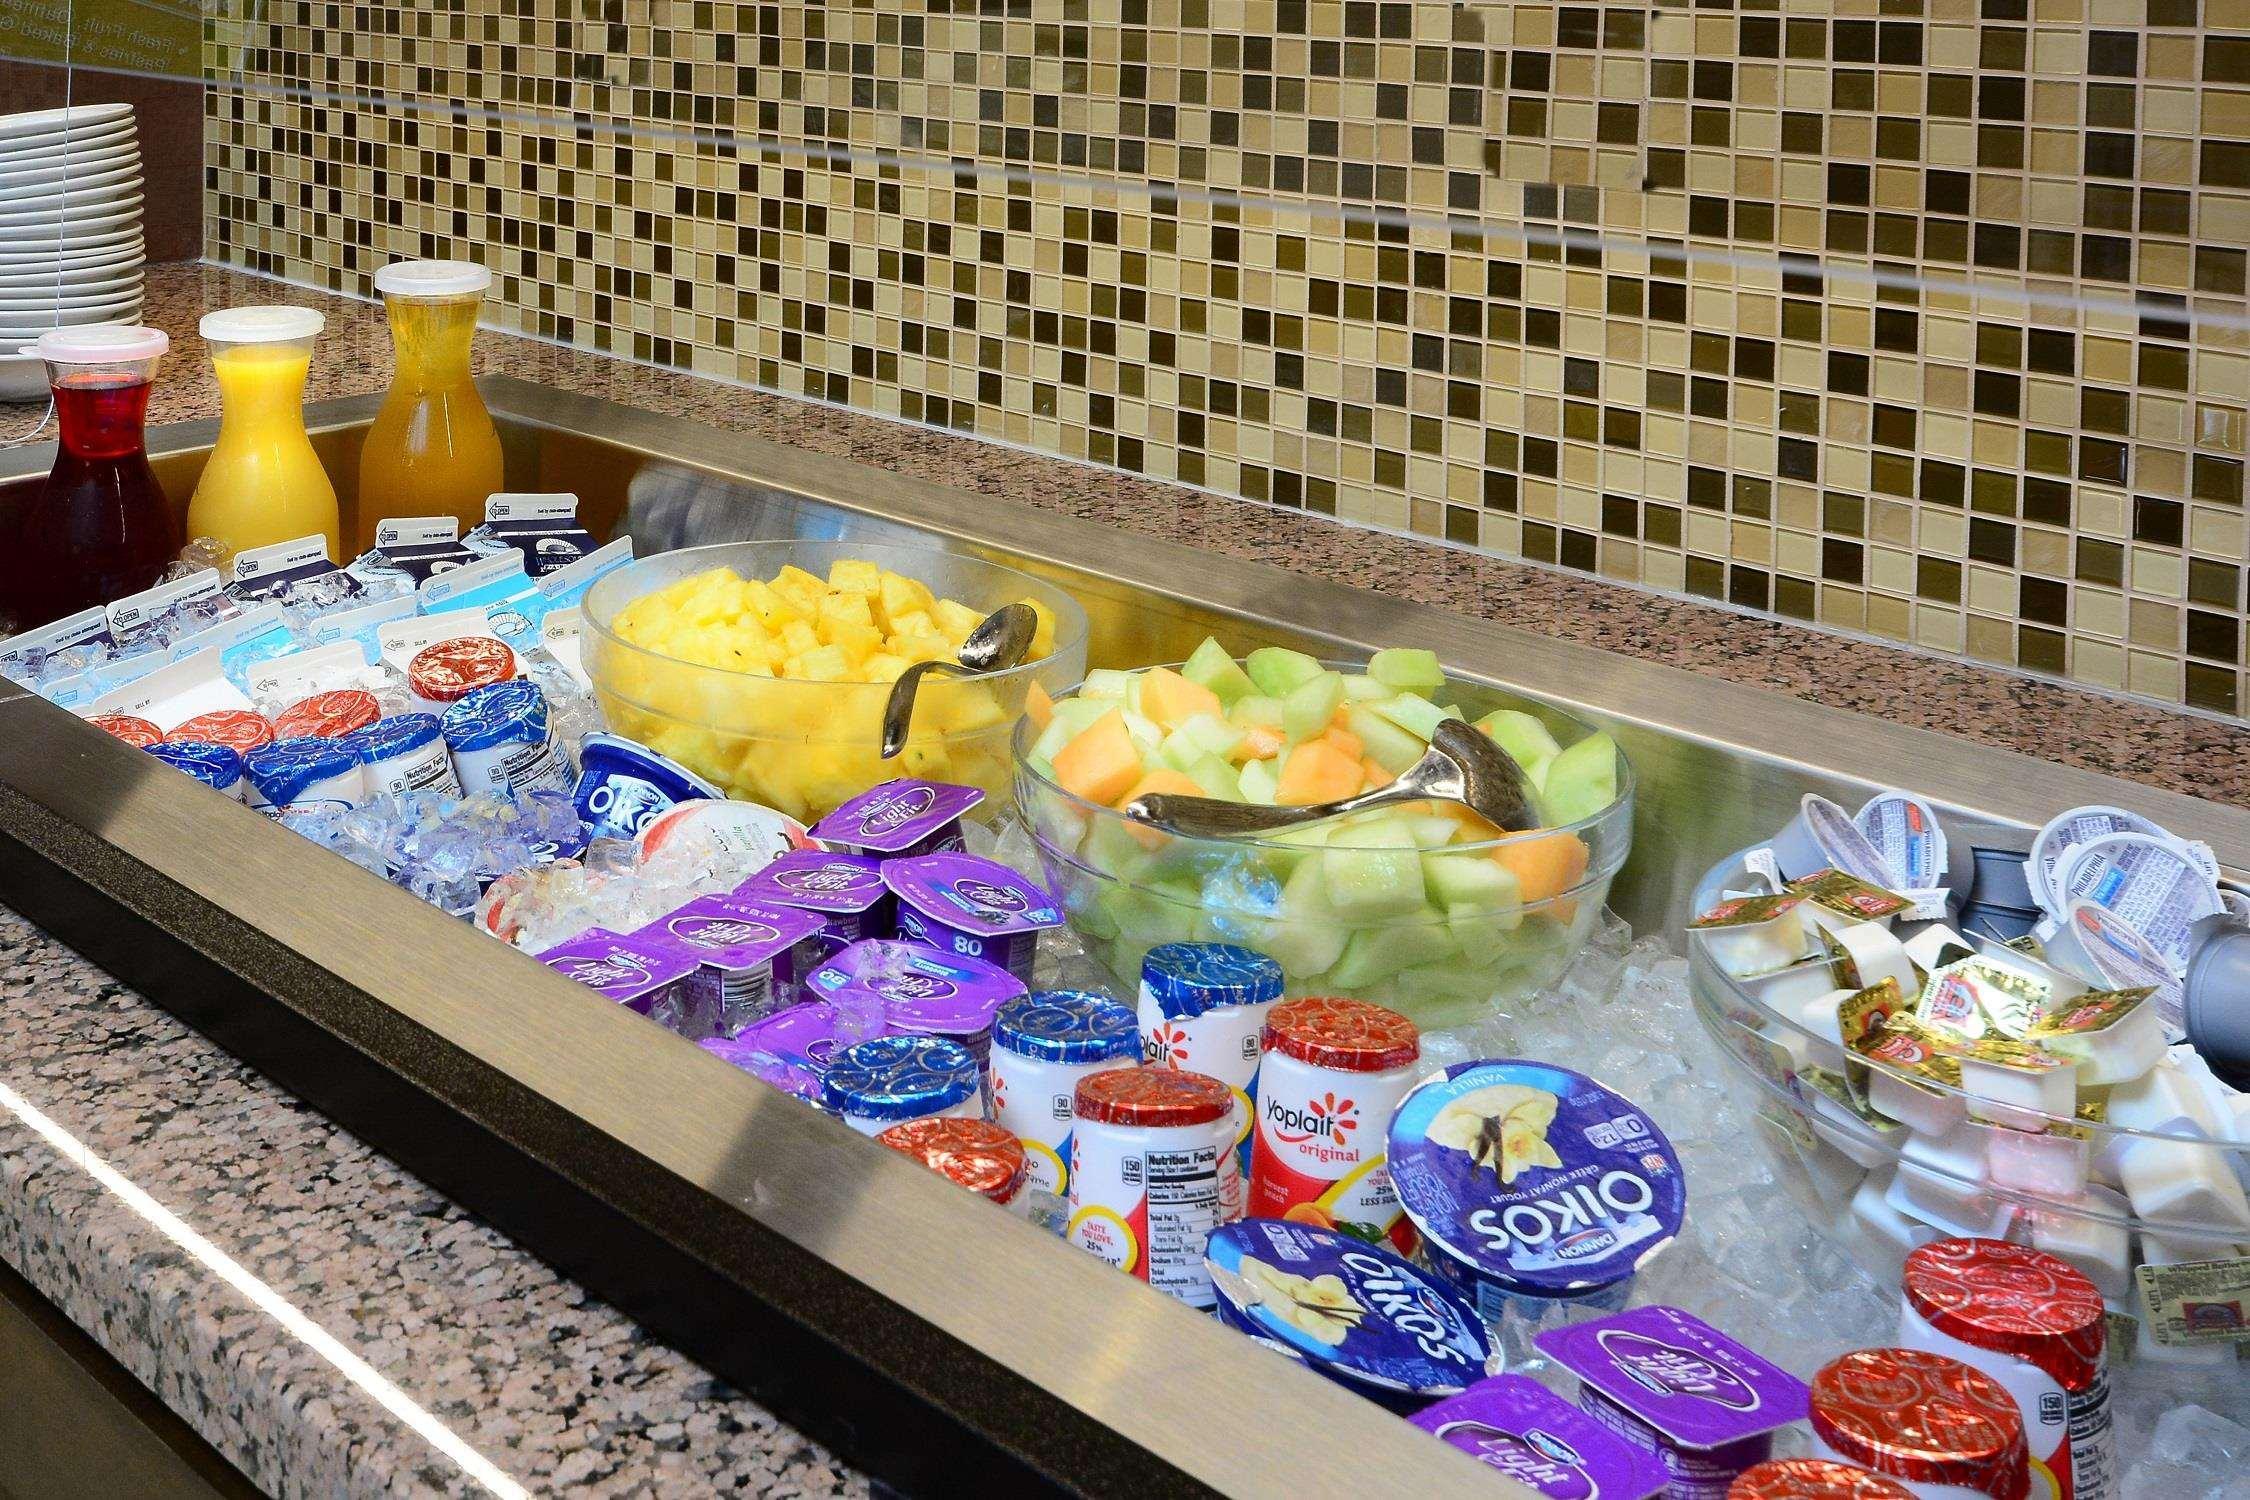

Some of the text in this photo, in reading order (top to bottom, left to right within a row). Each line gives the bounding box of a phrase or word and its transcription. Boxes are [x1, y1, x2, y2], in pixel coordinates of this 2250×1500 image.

[503, 750, 531, 767] Nutrition
[406, 763, 433, 780] Nutrition
[870, 798, 910, 826] Light
[2071, 853, 2107, 897] PHILADELPHIA
[954, 936, 983, 957] 80
[1246, 1038, 1255, 1048] 90
[1443, 1073, 1506, 1096] VANILLA
[1057, 1098, 1068, 1108] 90
[1267, 1094, 1334, 1136] Yoplait
[1592, 1132, 1617, 1145] 12g
[1148, 1151, 1215, 1166] Nutrition Facts
[1299, 1143, 1360, 1163] original
[1125, 1160, 1140, 1172] 150
[1490, 1164, 1600, 1204] GREEK NONFAT YOGURT
[1149, 1192, 1169, 1200] Calories
[1360, 1197, 1379, 1206] LESS
[1470, 1170, 1653, 1250] OIKOS
[1150, 1213, 1162, 1222] Total
[1164, 1213, 1173, 1221] Fat
[1082, 1228, 1092, 1239] YOU
[1087, 1221, 1106, 1233] TASTE
[1087, 1240, 1103, 1252] 25%
[1154, 1235, 1167, 1243] Trans
[1560, 1234, 1615, 1259] DANNON
[1151, 1268, 1165, 1276] Total
[2167, 1262, 2240, 1273] Whipped Butter
[1151, 1277, 1189, 1287] Carbohydrate
[1341, 1252, 1466, 1366] OIKOS
[1625, 1354, 1717, 1392] Light
[2043, 1396, 2060, 1409] 150
[1477, 1438, 1570, 1483] Light
